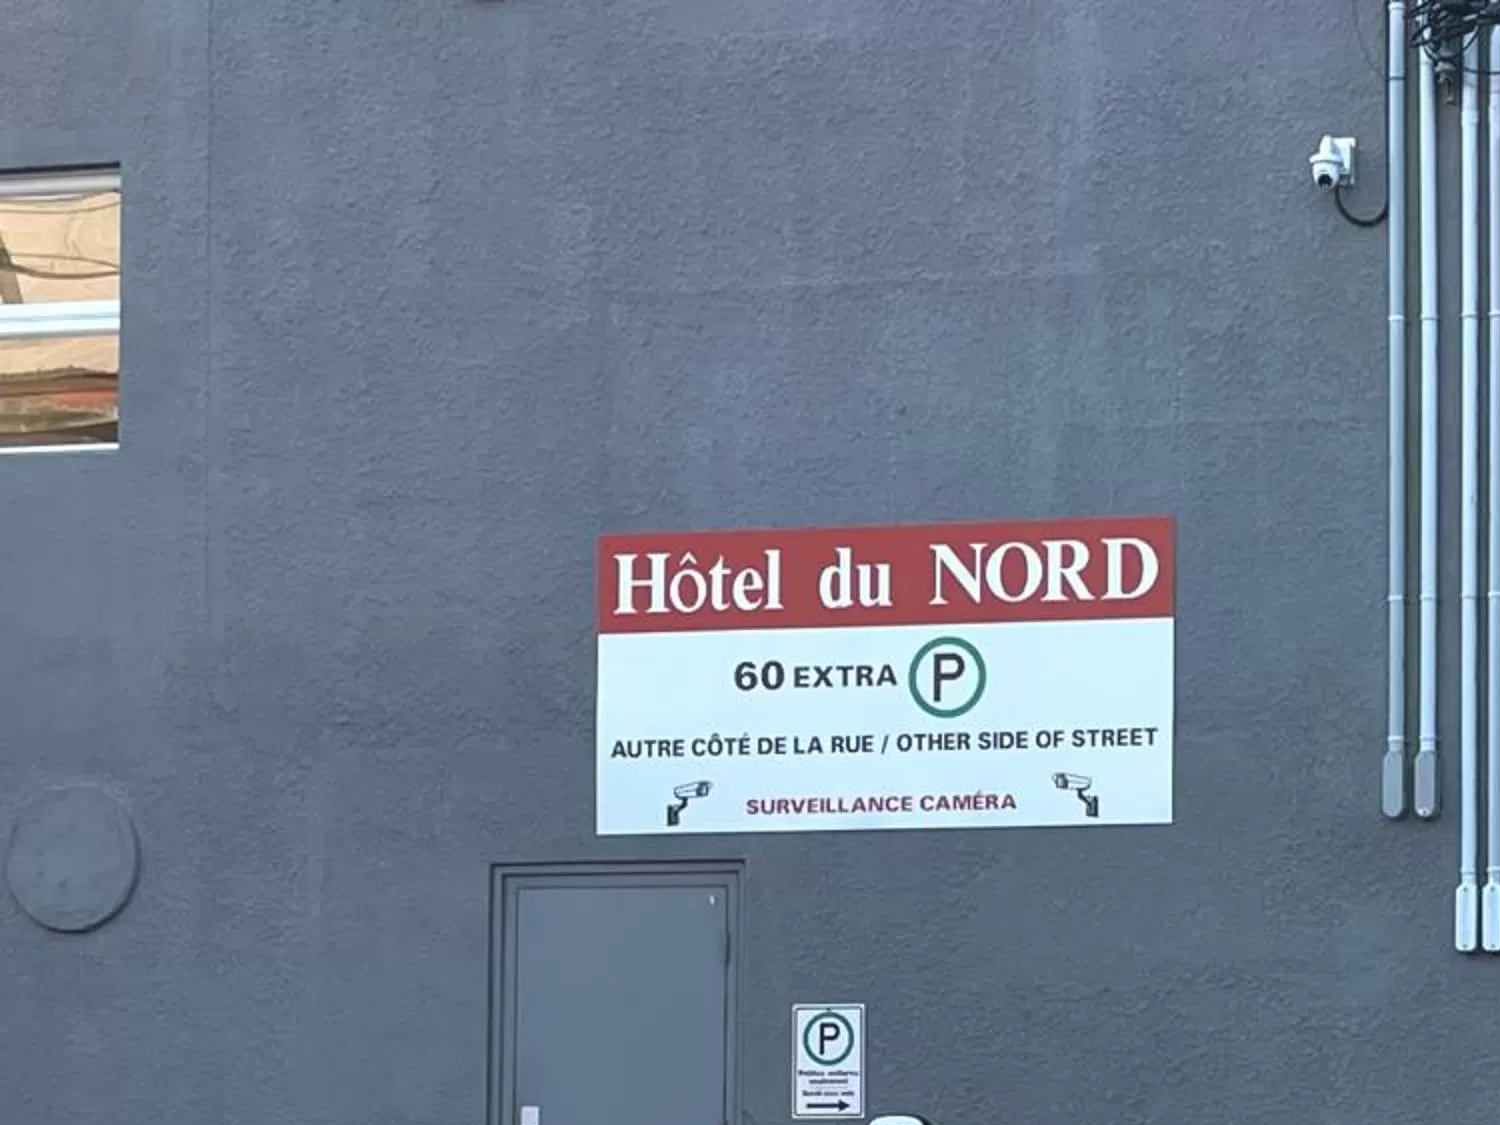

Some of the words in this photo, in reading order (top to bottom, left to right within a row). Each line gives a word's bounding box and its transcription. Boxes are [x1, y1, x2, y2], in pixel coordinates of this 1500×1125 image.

[613, 549, 784, 615] Hôtel
[819, 546, 893, 609] du
[929, 537, 1159, 605] NORD
[734, 660, 785, 691] 60
[793, 664, 898, 688] EXTRA
[933, 652, 965, 702] P
[611, 739, 684, 758] AUTRE
[691, 733, 751, 757] CÔTÉ
[757, 736, 786, 755] DE
[793, 736, 823, 755] LA
[831, 735, 874, 753] RUE
[880, 734, 890, 754] /
[897, 732, 970, 752] OTHER
[977, 730, 1028, 750] SIDE
[1035, 729, 1065, 749] OF
[1072, 727, 1158, 747] STREET
[746, 795, 912, 815] SURVEILLANCE
[919, 790, 1017, 811] CAMÉRA
[820, 1022, 840, 1055] P
